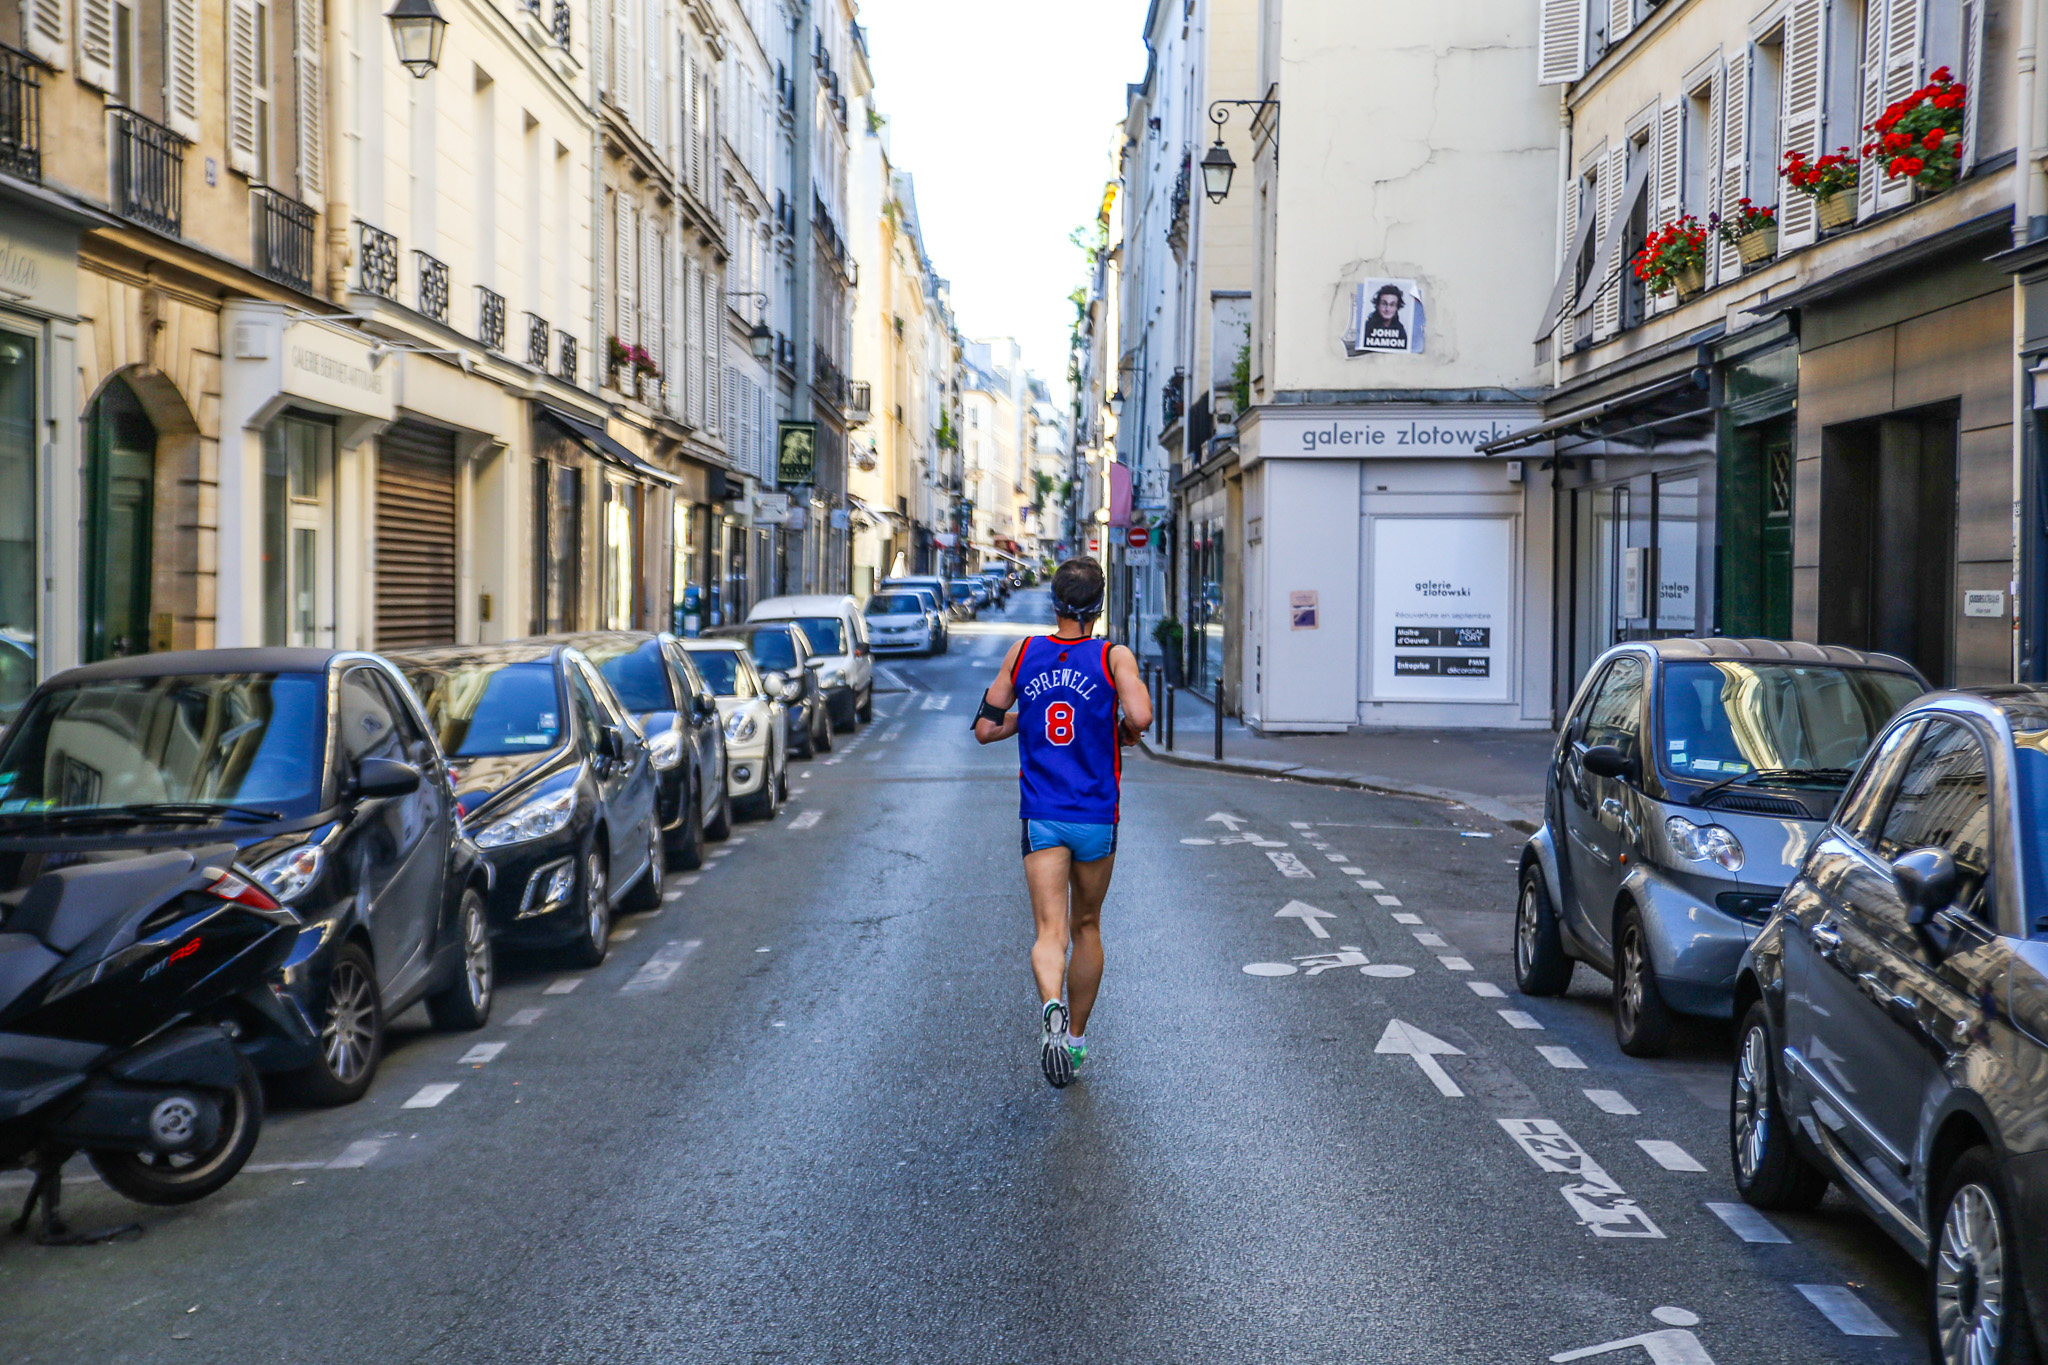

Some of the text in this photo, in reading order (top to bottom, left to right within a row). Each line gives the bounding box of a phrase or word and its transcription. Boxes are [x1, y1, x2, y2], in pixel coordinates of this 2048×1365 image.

[1370, 328, 1400, 338] JOHN
[1365, 337, 1406, 348] HAMON
[1302, 421, 1511, 451] galerie zlotowski
[1415, 579, 1452, 591] galerie
[1423, 587, 1471, 597] zlotowski
[1397, 662, 1431, 671] Entreprise
[1024, 668, 1098, 701] SPREWELL
[1045, 701, 1075, 746] 8
